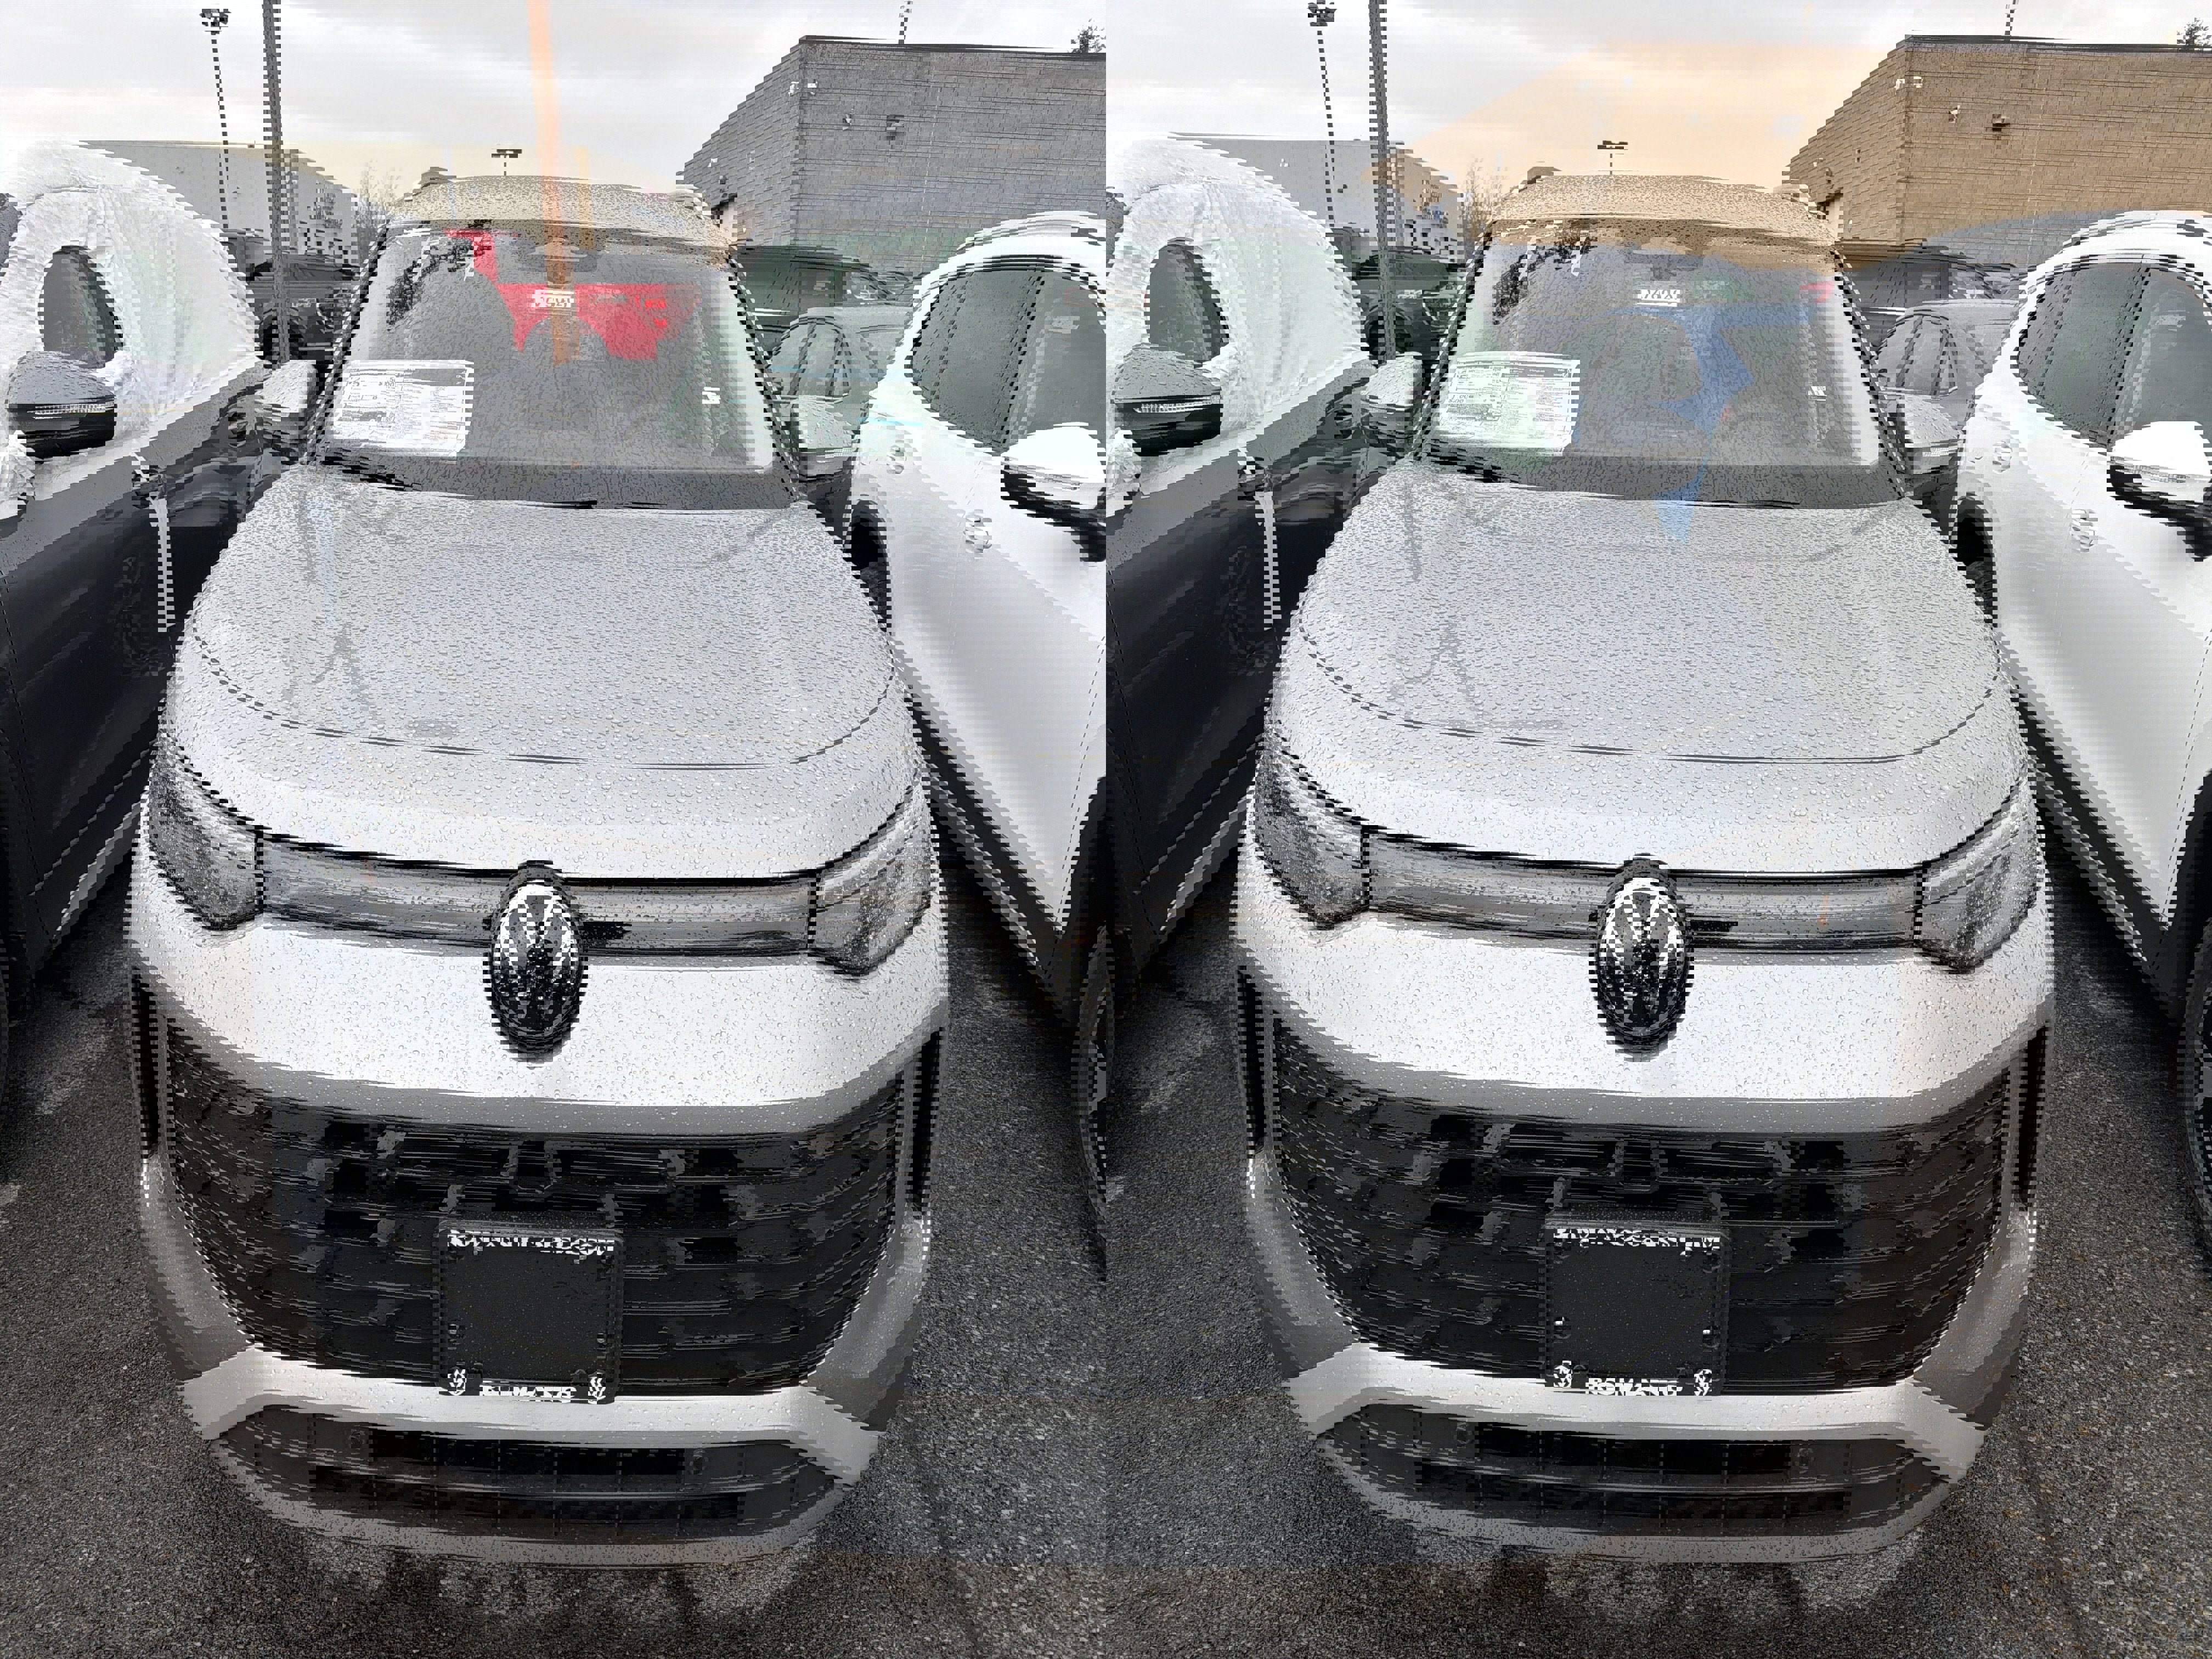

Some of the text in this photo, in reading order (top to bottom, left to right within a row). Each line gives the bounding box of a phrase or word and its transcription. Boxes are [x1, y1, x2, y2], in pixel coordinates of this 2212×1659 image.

[590, 294, 627, 304] FX4
[1076, 292, 1138, 304] V79040
[898, 1229, 1221, 1254] ROMANOCARS.COM
[962, 1380, 1147, 1399] ROMANO
